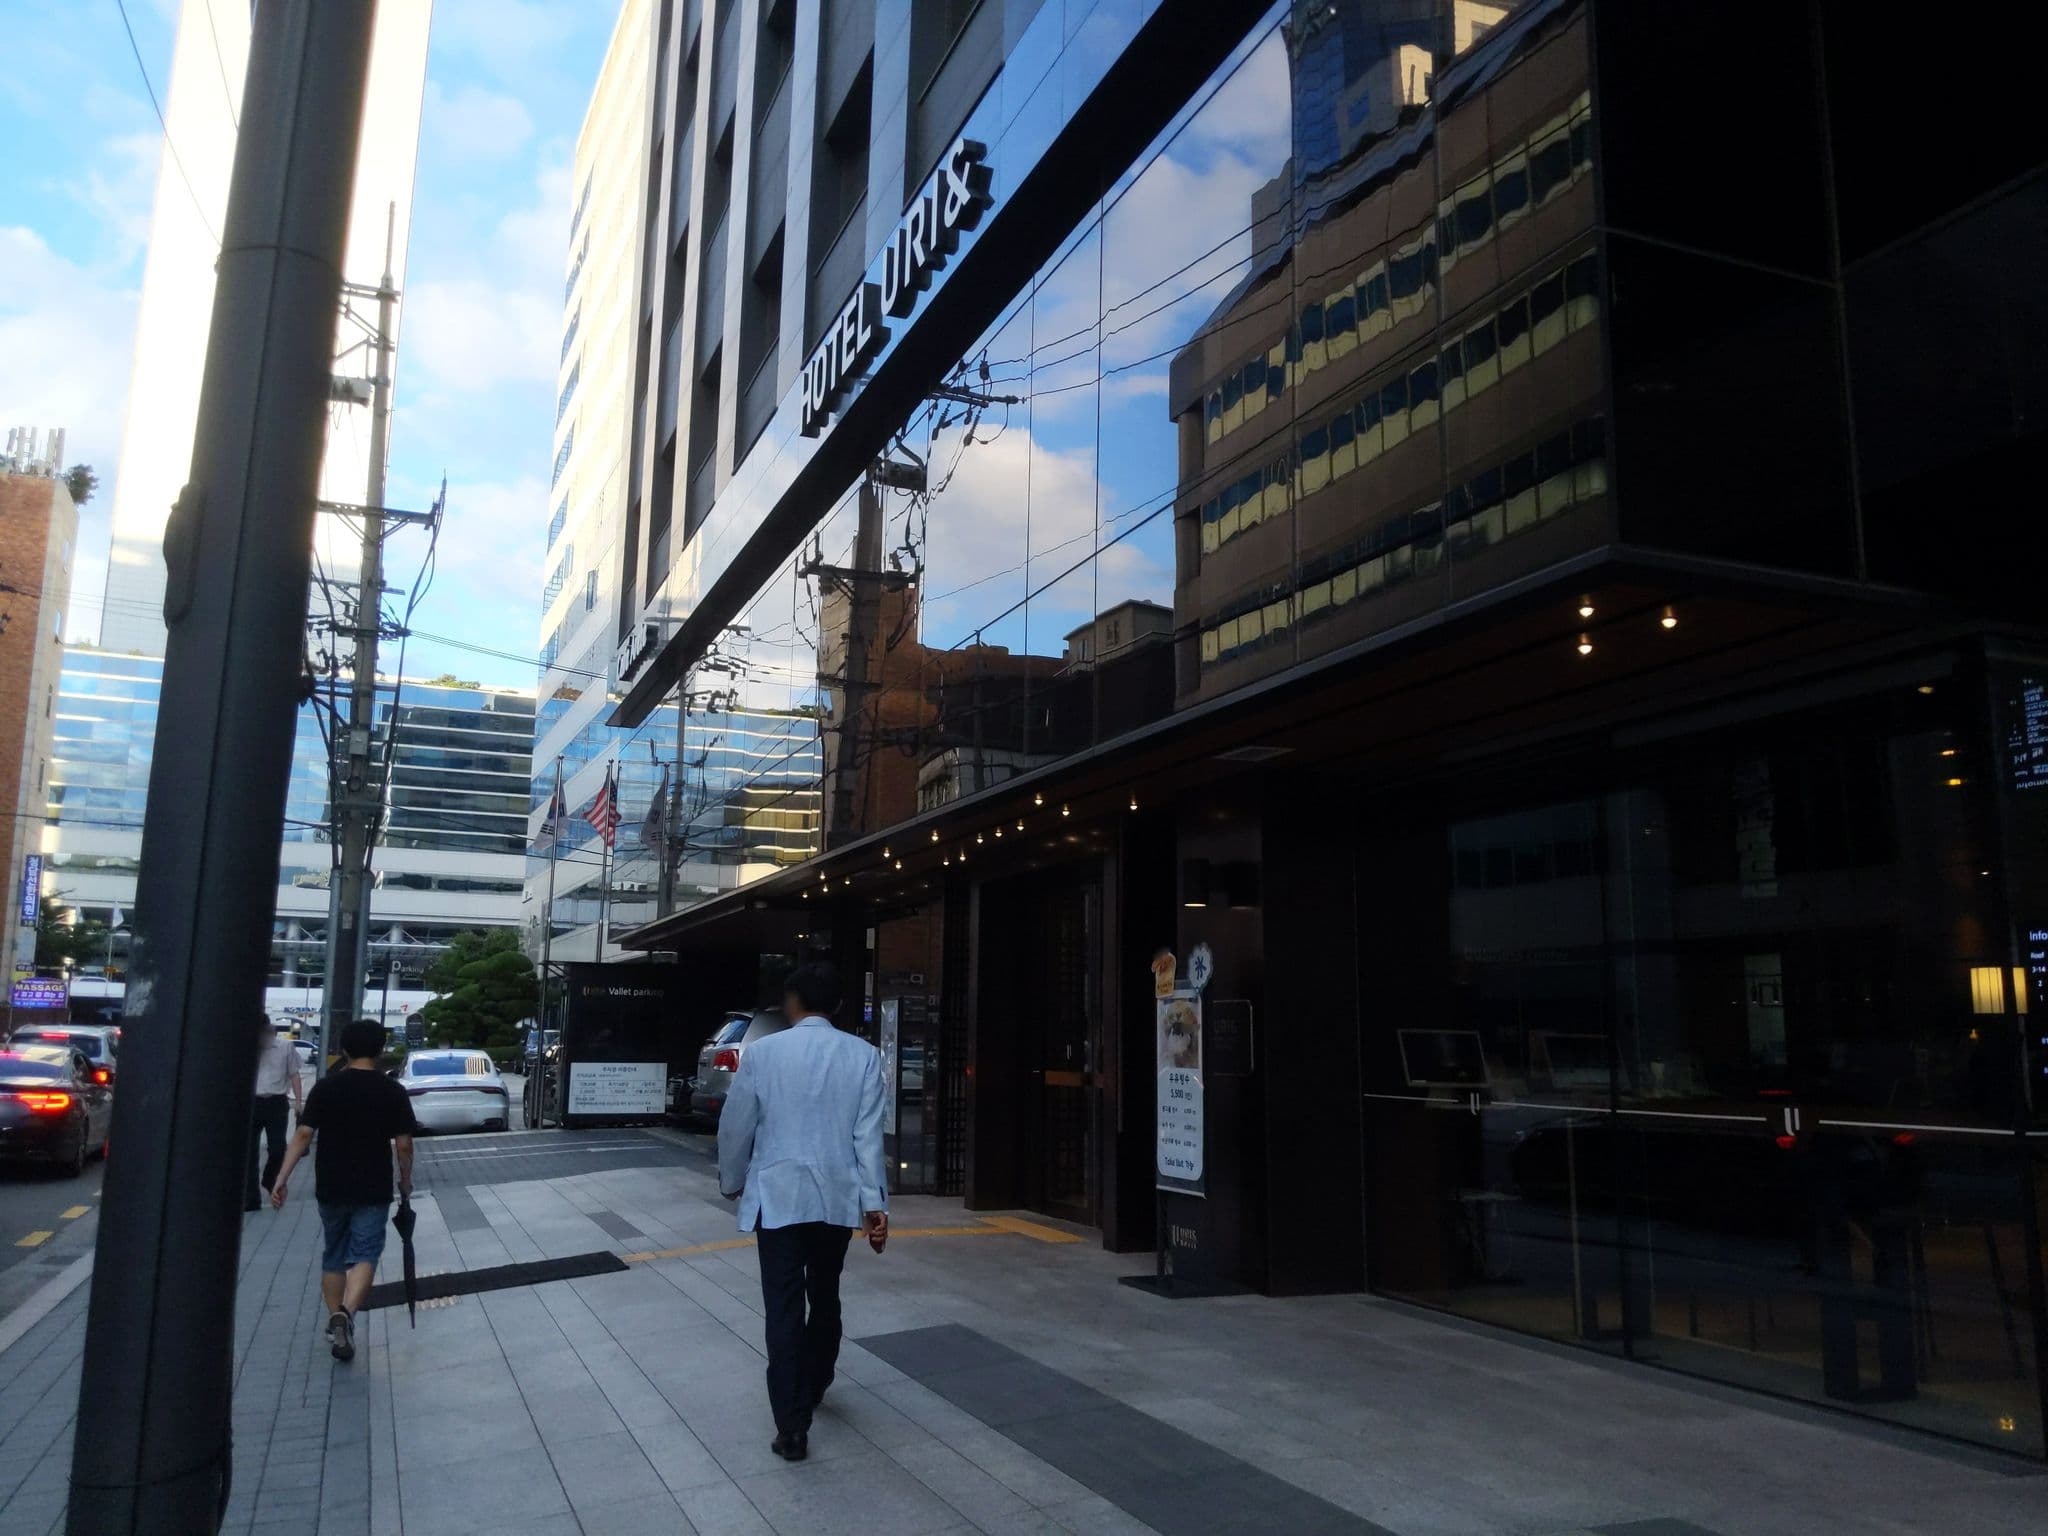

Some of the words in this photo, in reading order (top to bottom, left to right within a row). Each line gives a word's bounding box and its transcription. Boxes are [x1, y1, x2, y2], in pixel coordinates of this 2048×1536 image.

[800, 282, 881, 437] HOTEL
[880, 137, 990, 318] URI&
[391, 960, 425, 975] Parking
[14, 983, 65, 992] MASSAGE
